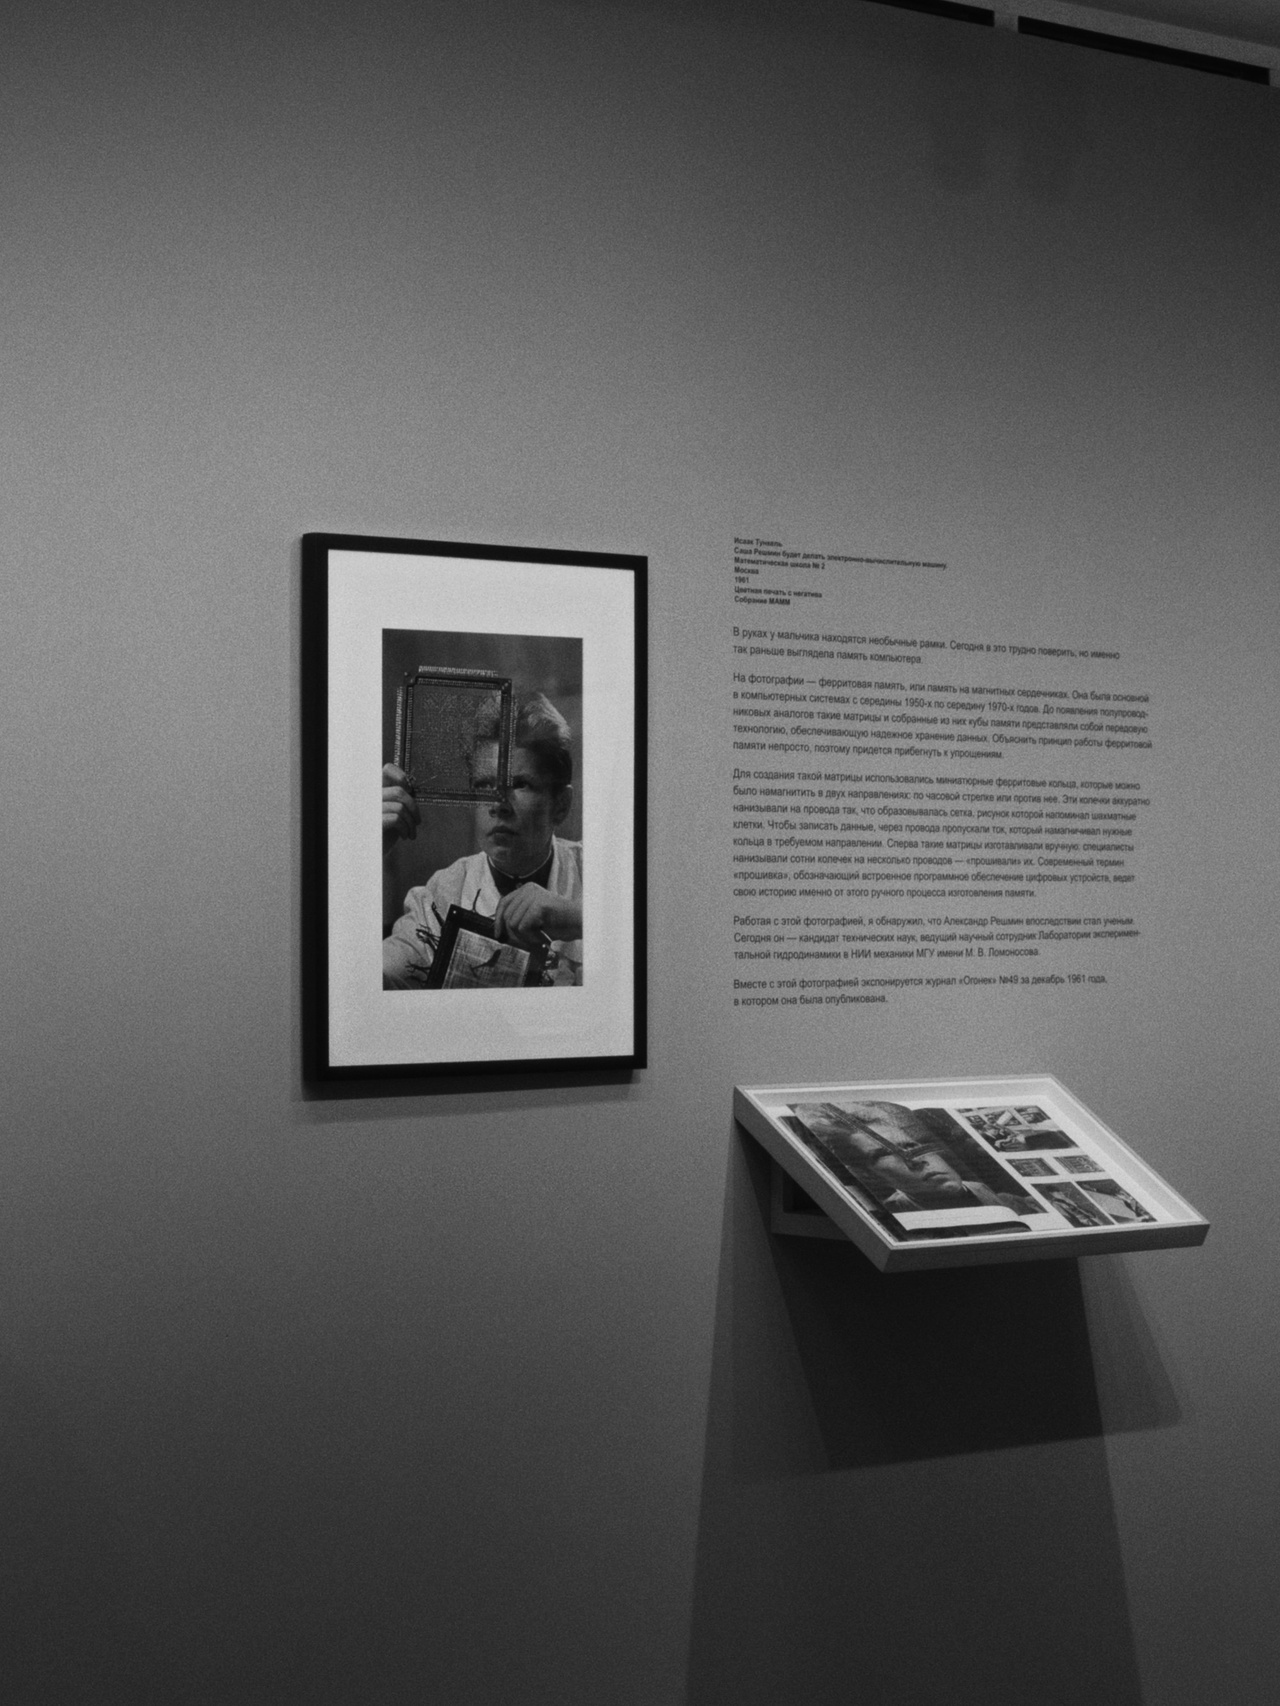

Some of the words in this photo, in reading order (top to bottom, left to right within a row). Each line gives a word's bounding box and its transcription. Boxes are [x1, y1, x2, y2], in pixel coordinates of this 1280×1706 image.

[742, 629, 768, 639] руках
[777, 632, 820, 641] мальчика
[821, 634, 867, 644] находятся
[868, 636, 918, 647] необычные
[919, 640, 948, 649] рамки.
[949, 640, 984, 652] Сегодня
[993, 645, 1007, 653] это
[1009, 645, 1037, 655] трудно
[1038, 647, 1078, 657] поверить,
[1090, 651, 1120, 660] именно
[733, 645, 748, 654] так
[749, 646, 785, 656] раньше
[786, 649, 835, 659] выглядела
[836, 651, 868, 661] память
[740, 692, 807, 702] компьютерных
[808, 695, 850, 704] системах
[860, 697, 902, 707] середины
[905, 697, 932, 708] 1950-х
[946, 701, 986, 712] середину
[988, 701, 1014, 712] 1970-х
[1016, 704, 1041, 714] годов.
[1042, 703, 1055, 714] До
[1055, 707, 1099, 716] появления
[733, 741, 767, 750] памяти
[768, 743, 812, 753] непросто,
[814, 744, 851, 755] поэтому
[852, 746, 893, 755] придется
[894, 746, 942, 758] прибегнуть
[733, 888, 757, 897] свою
[758, 888, 797, 898] историю
[798, 889, 833, 897] именно
[846, 889, 869, 897] этого
[870, 889, 905, 898] ручного
[906, 889, 947, 898] процесса
[947, 889, 1003, 897] изготовления
[733, 979, 767, 989] Вместе
[777, 978, 797, 988] этой
[798, 978, 859, 989] фотографией
[861, 978, 924, 987] экспонируется
[925, 978, 957, 987] журнал
[998, 975, 1019, 984] №49
[1031, 974, 1065, 985] декабрь
[1067, 974, 1086, 984] 1961
